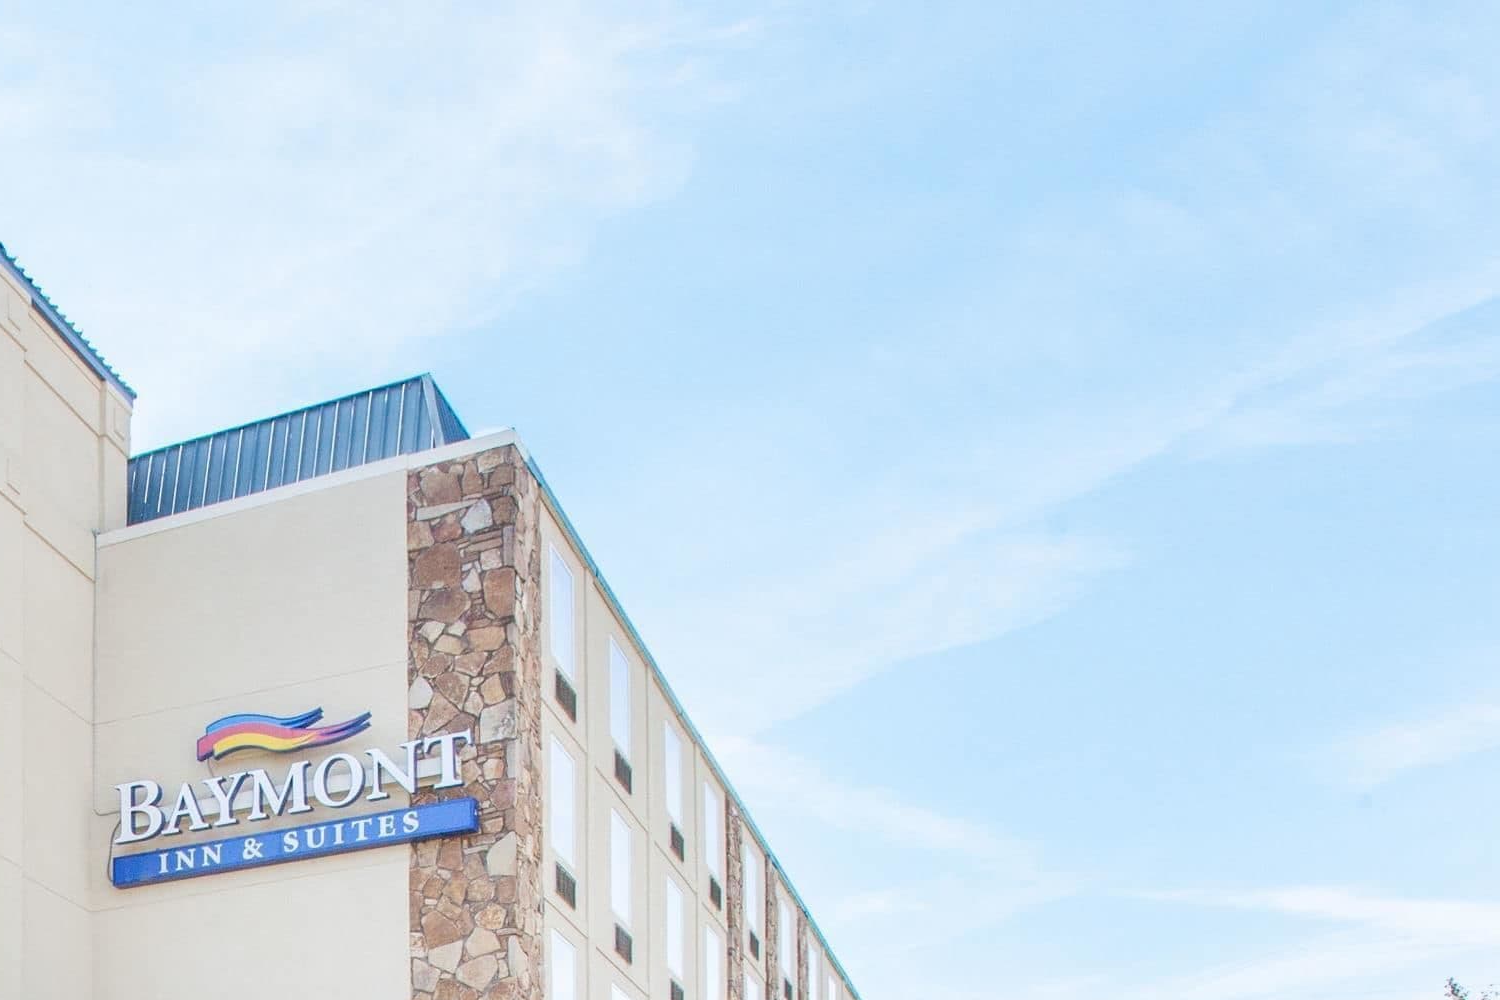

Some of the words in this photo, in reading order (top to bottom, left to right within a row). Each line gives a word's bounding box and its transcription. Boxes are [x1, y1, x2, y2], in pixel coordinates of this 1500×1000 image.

[114, 728, 473, 844] BAYMONT
[159, 845, 222, 874] INN
[243, 837, 263, 860] &
[283, 811, 420, 853] SUITES
